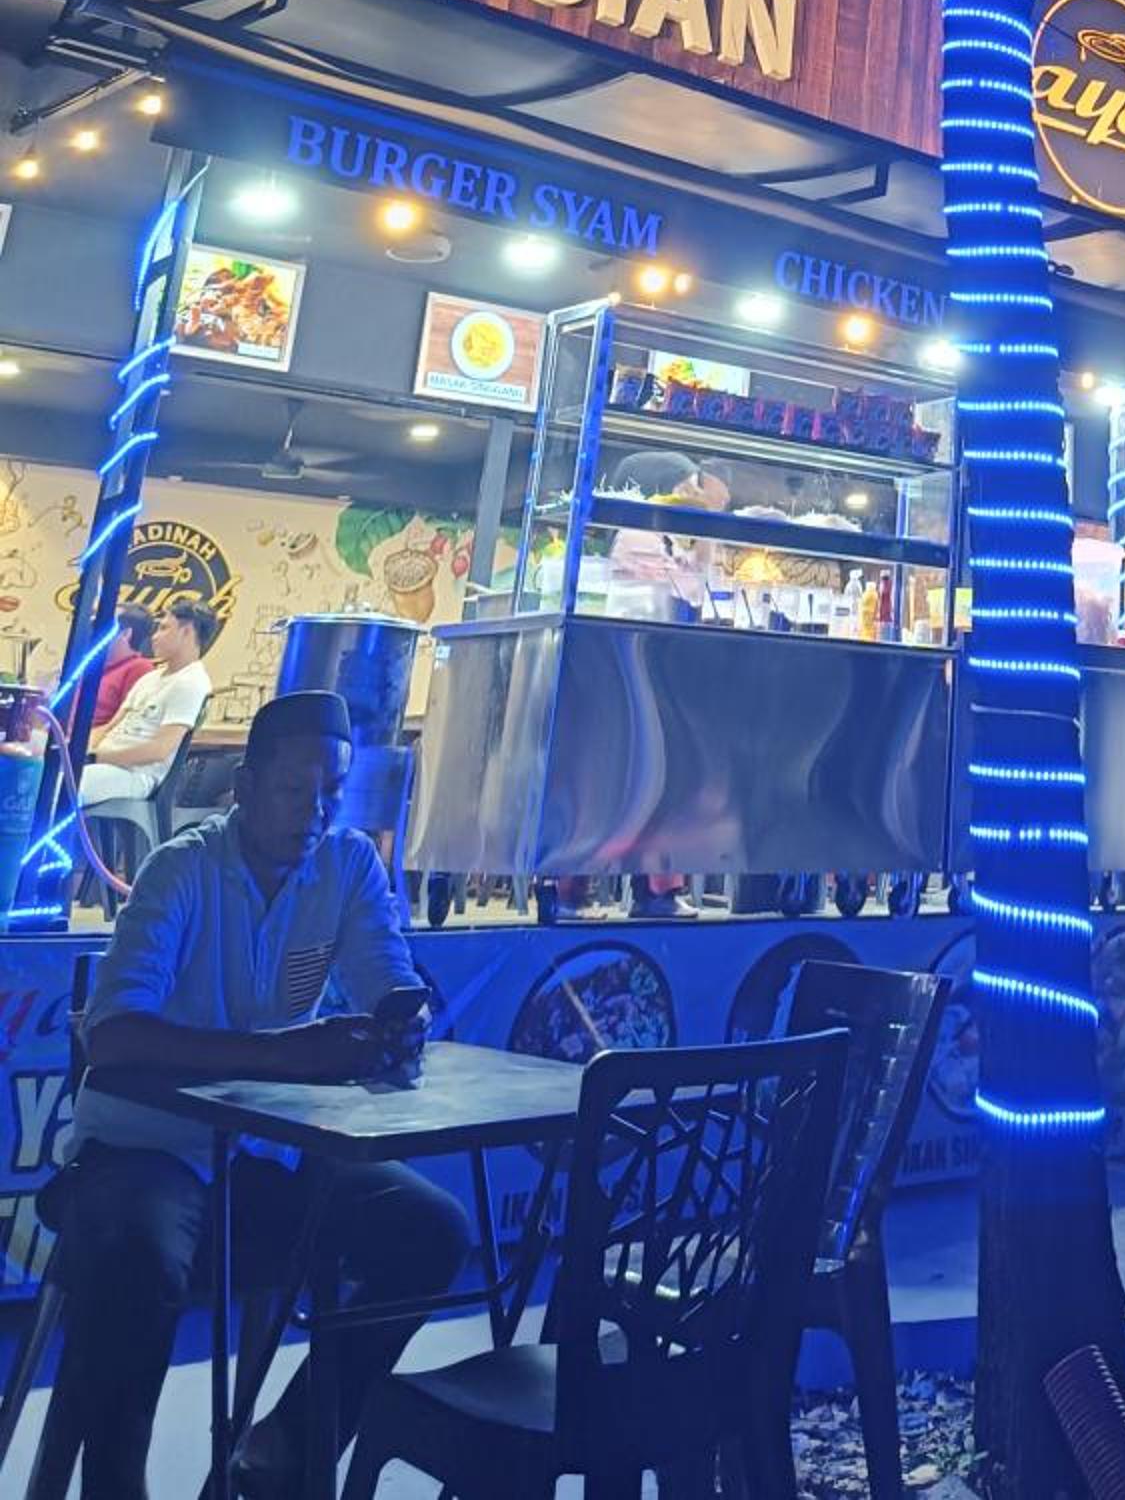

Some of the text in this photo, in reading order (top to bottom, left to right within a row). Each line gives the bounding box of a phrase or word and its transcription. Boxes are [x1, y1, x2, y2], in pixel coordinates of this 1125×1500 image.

[287, 116, 662, 256] BURGER SYAM
[775, 252, 946, 324] CHICKEN
